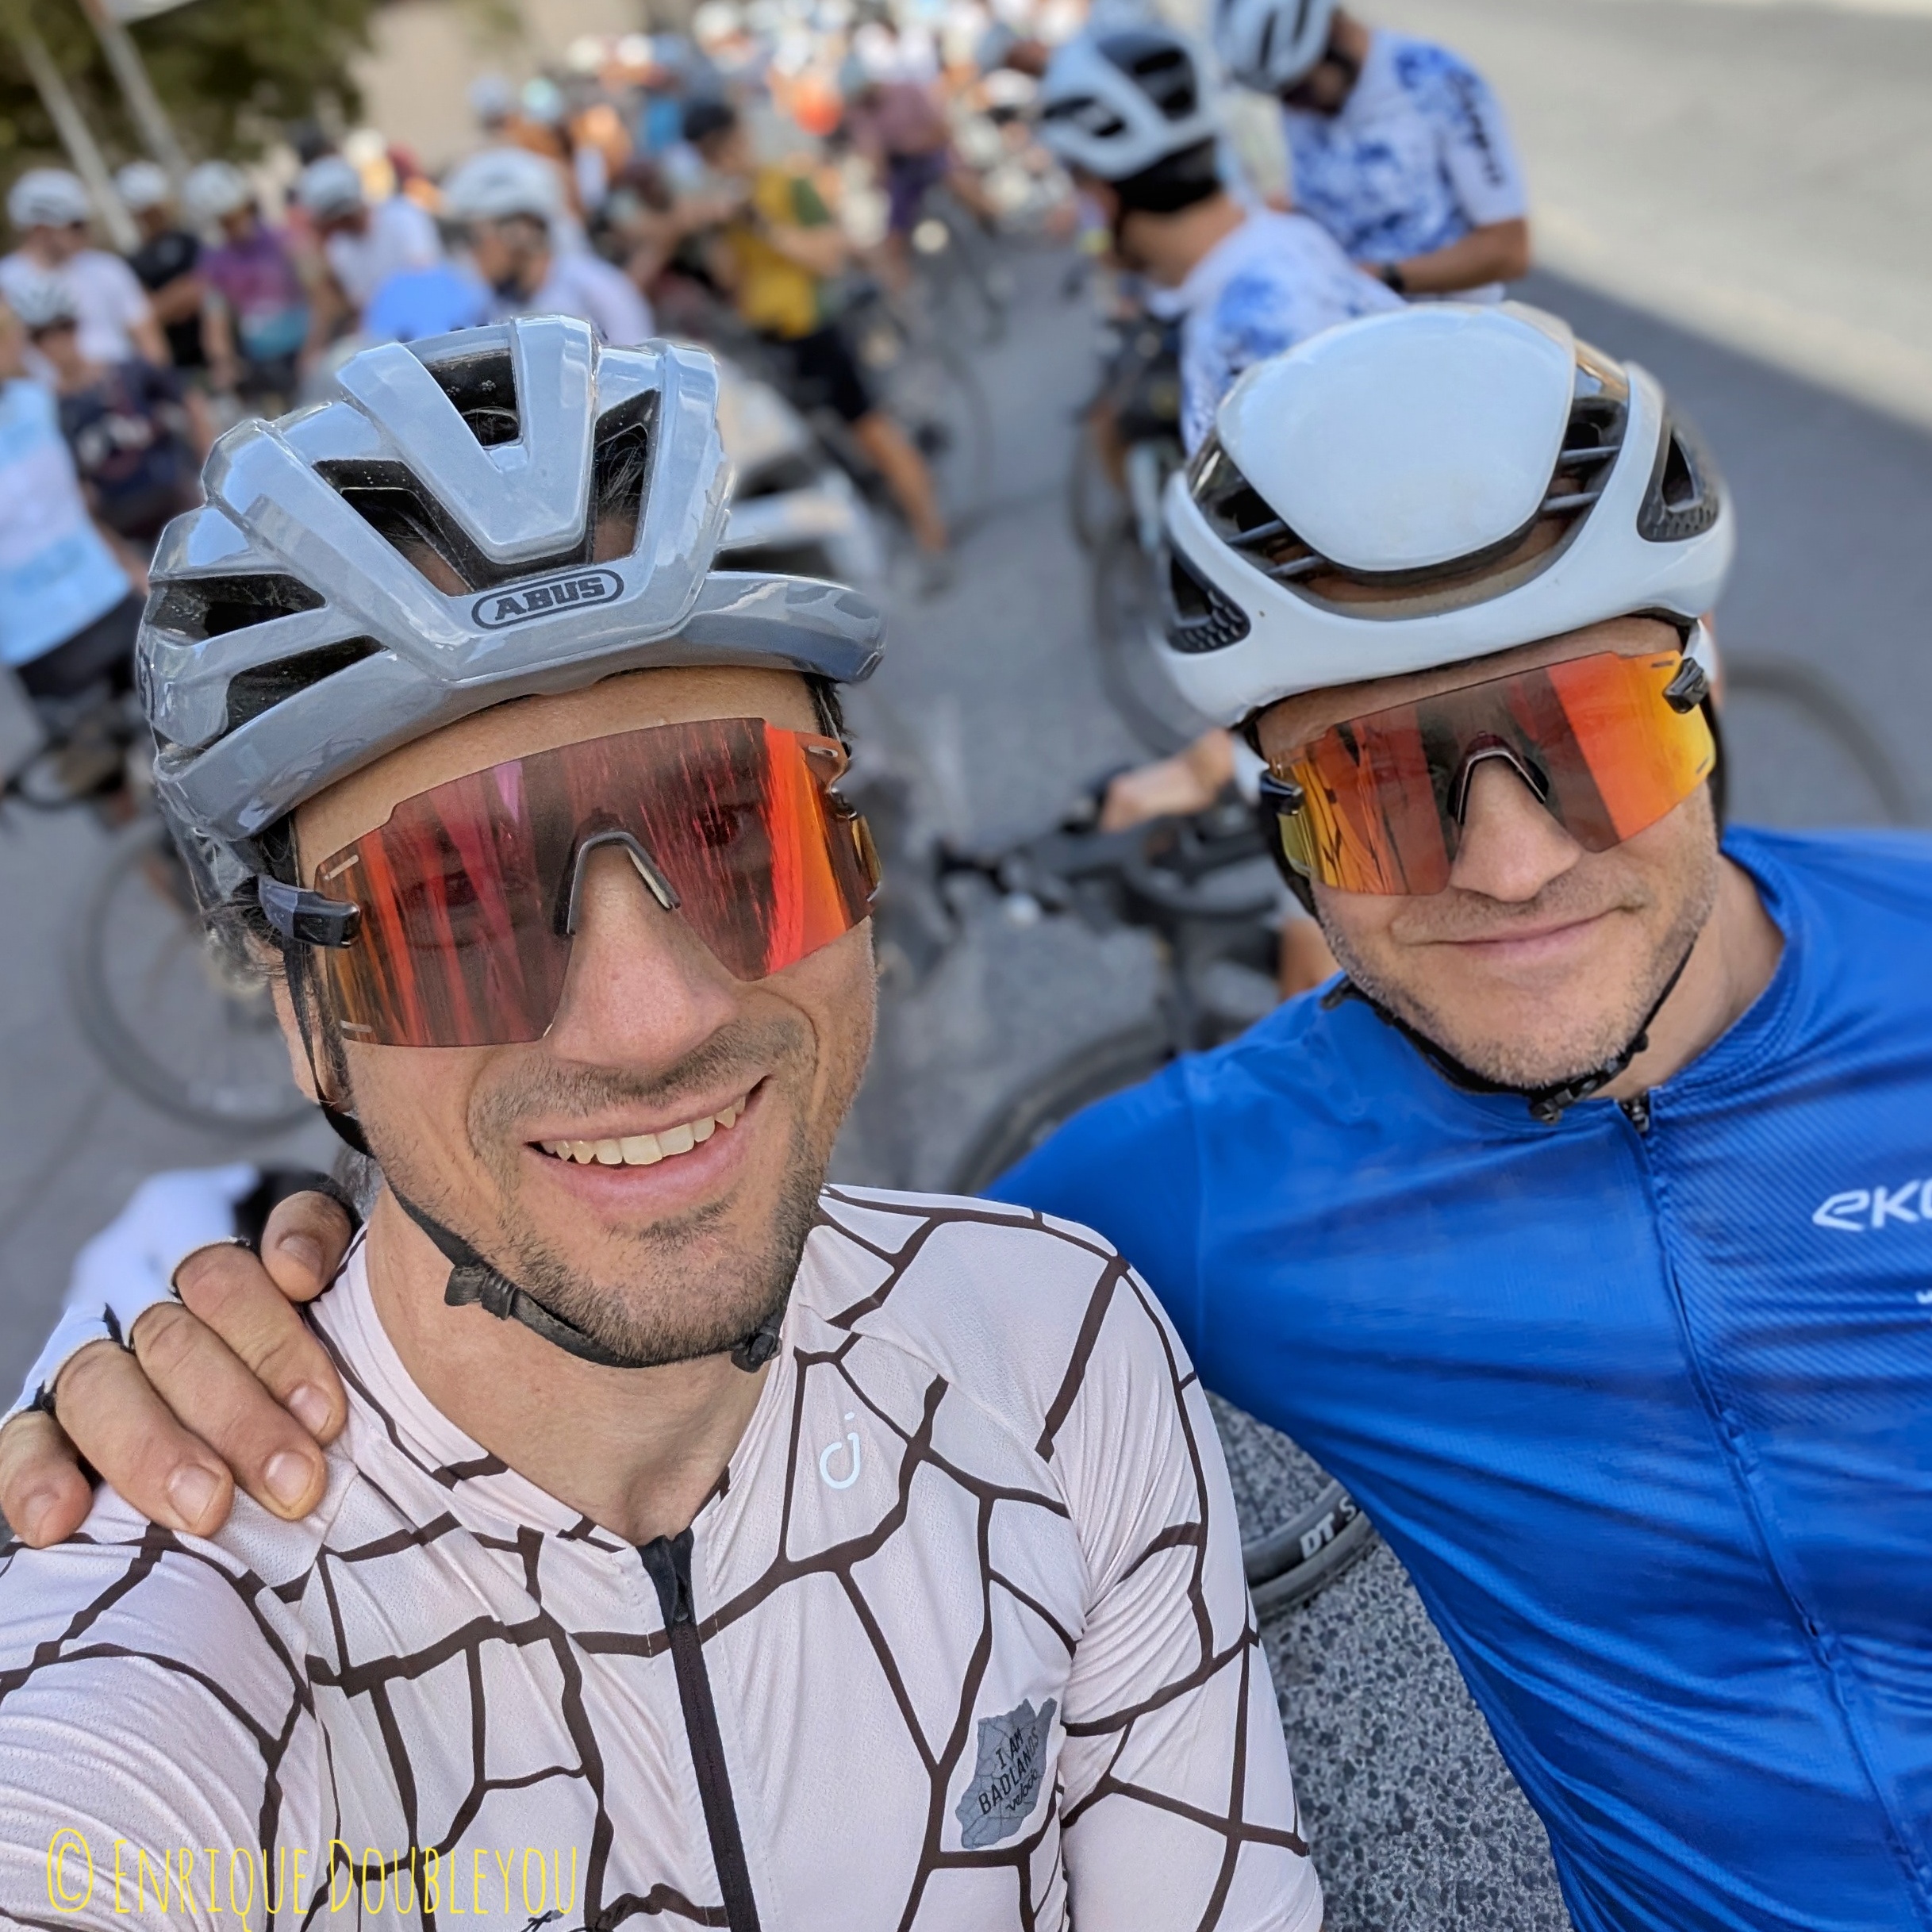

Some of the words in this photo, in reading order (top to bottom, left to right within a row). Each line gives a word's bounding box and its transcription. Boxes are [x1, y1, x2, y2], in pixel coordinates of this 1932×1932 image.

[495, 577, 605, 620] ABUS
[1300, 1511, 1335, 1559] DT
[978, 1727, 1039, 1815] BADLANDS
[996, 1748, 1007, 1770] I
[1009, 1727, 1024, 1759] AM
